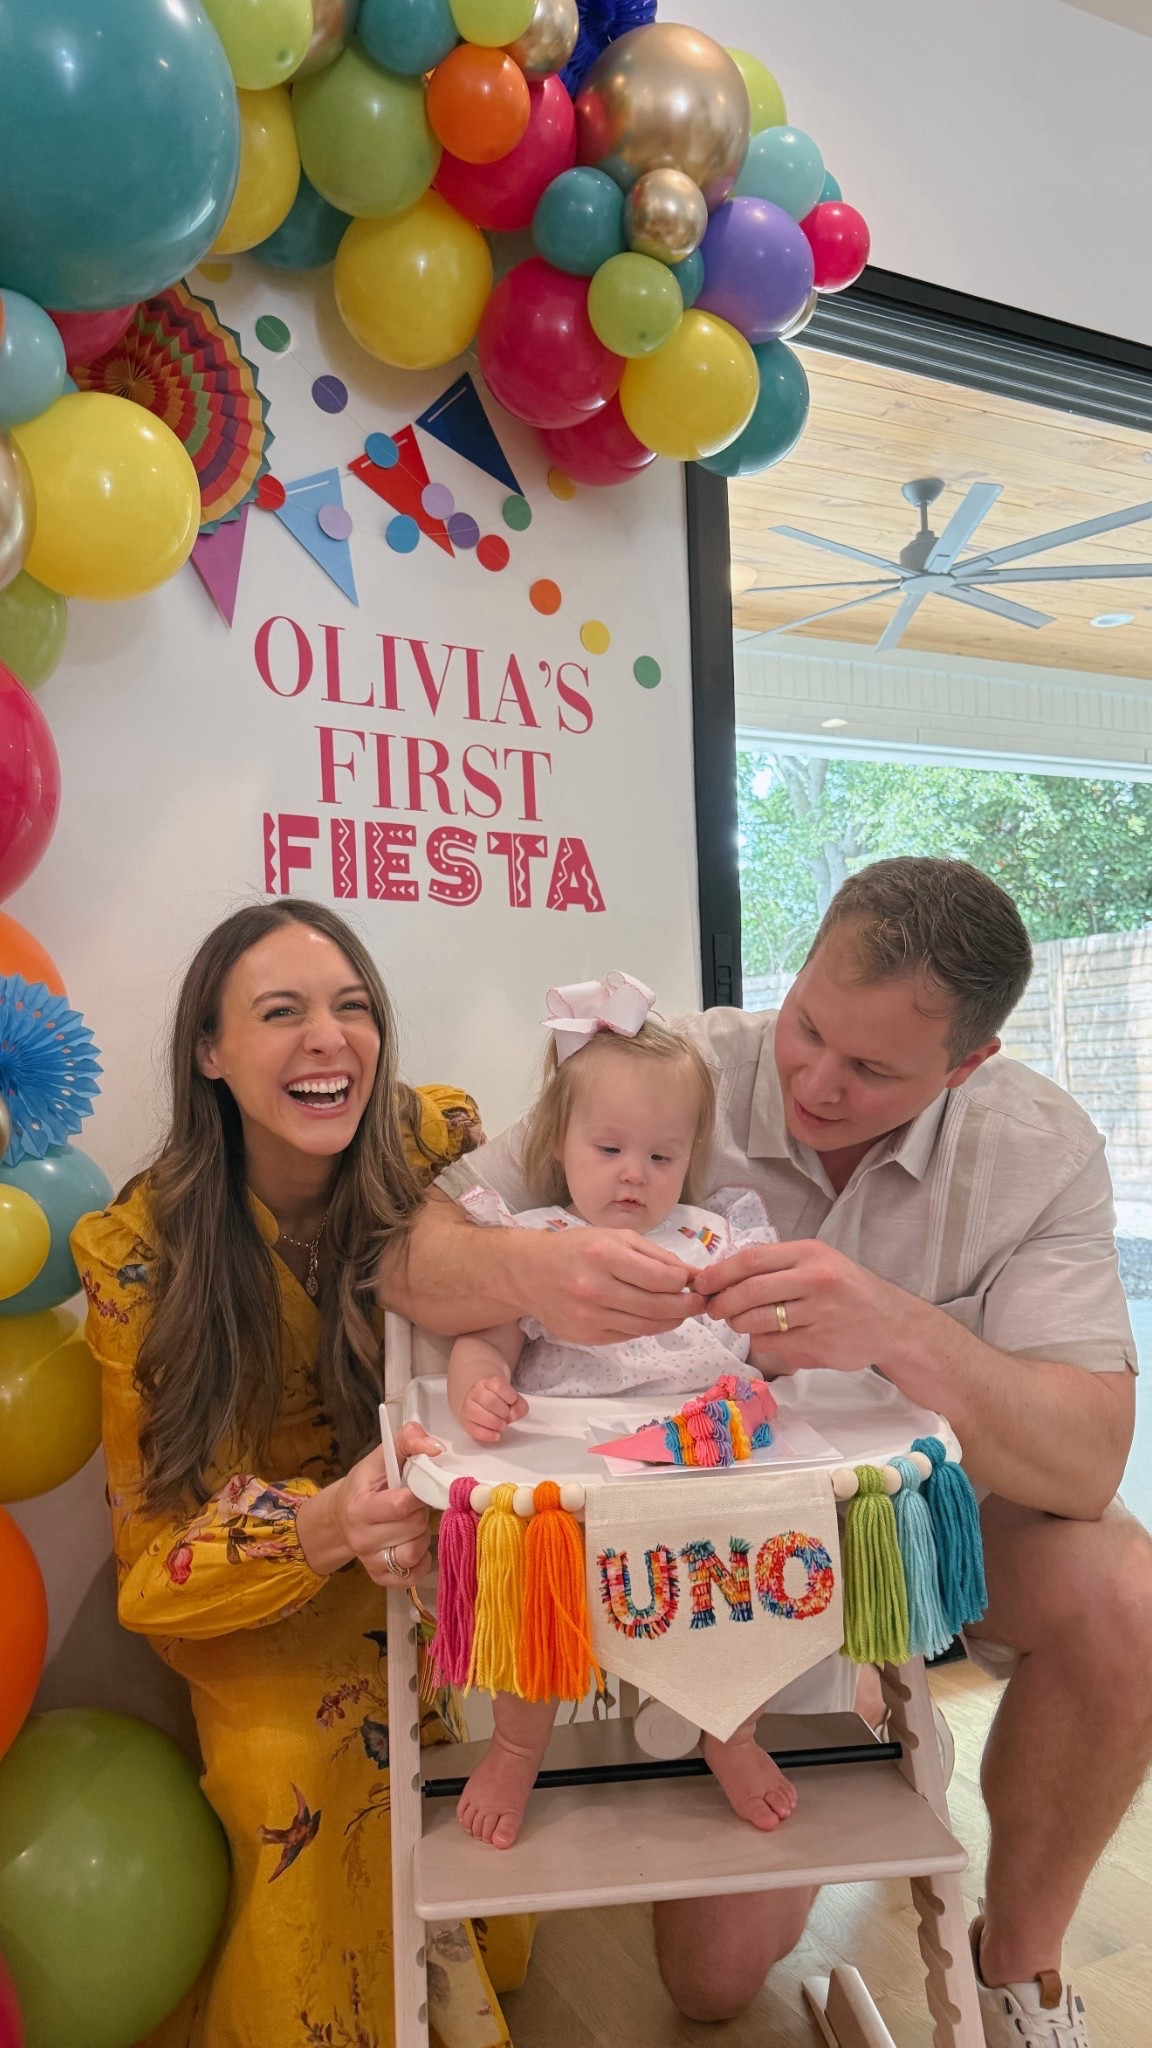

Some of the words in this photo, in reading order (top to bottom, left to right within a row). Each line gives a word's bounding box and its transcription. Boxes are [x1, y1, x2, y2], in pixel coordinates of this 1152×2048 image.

[254, 616, 593, 734] OLIVIA'S
[314, 725, 552, 822] FIRST
[263, 813, 606, 913] FIESTA
[597, 1530, 835, 1640] UNO
